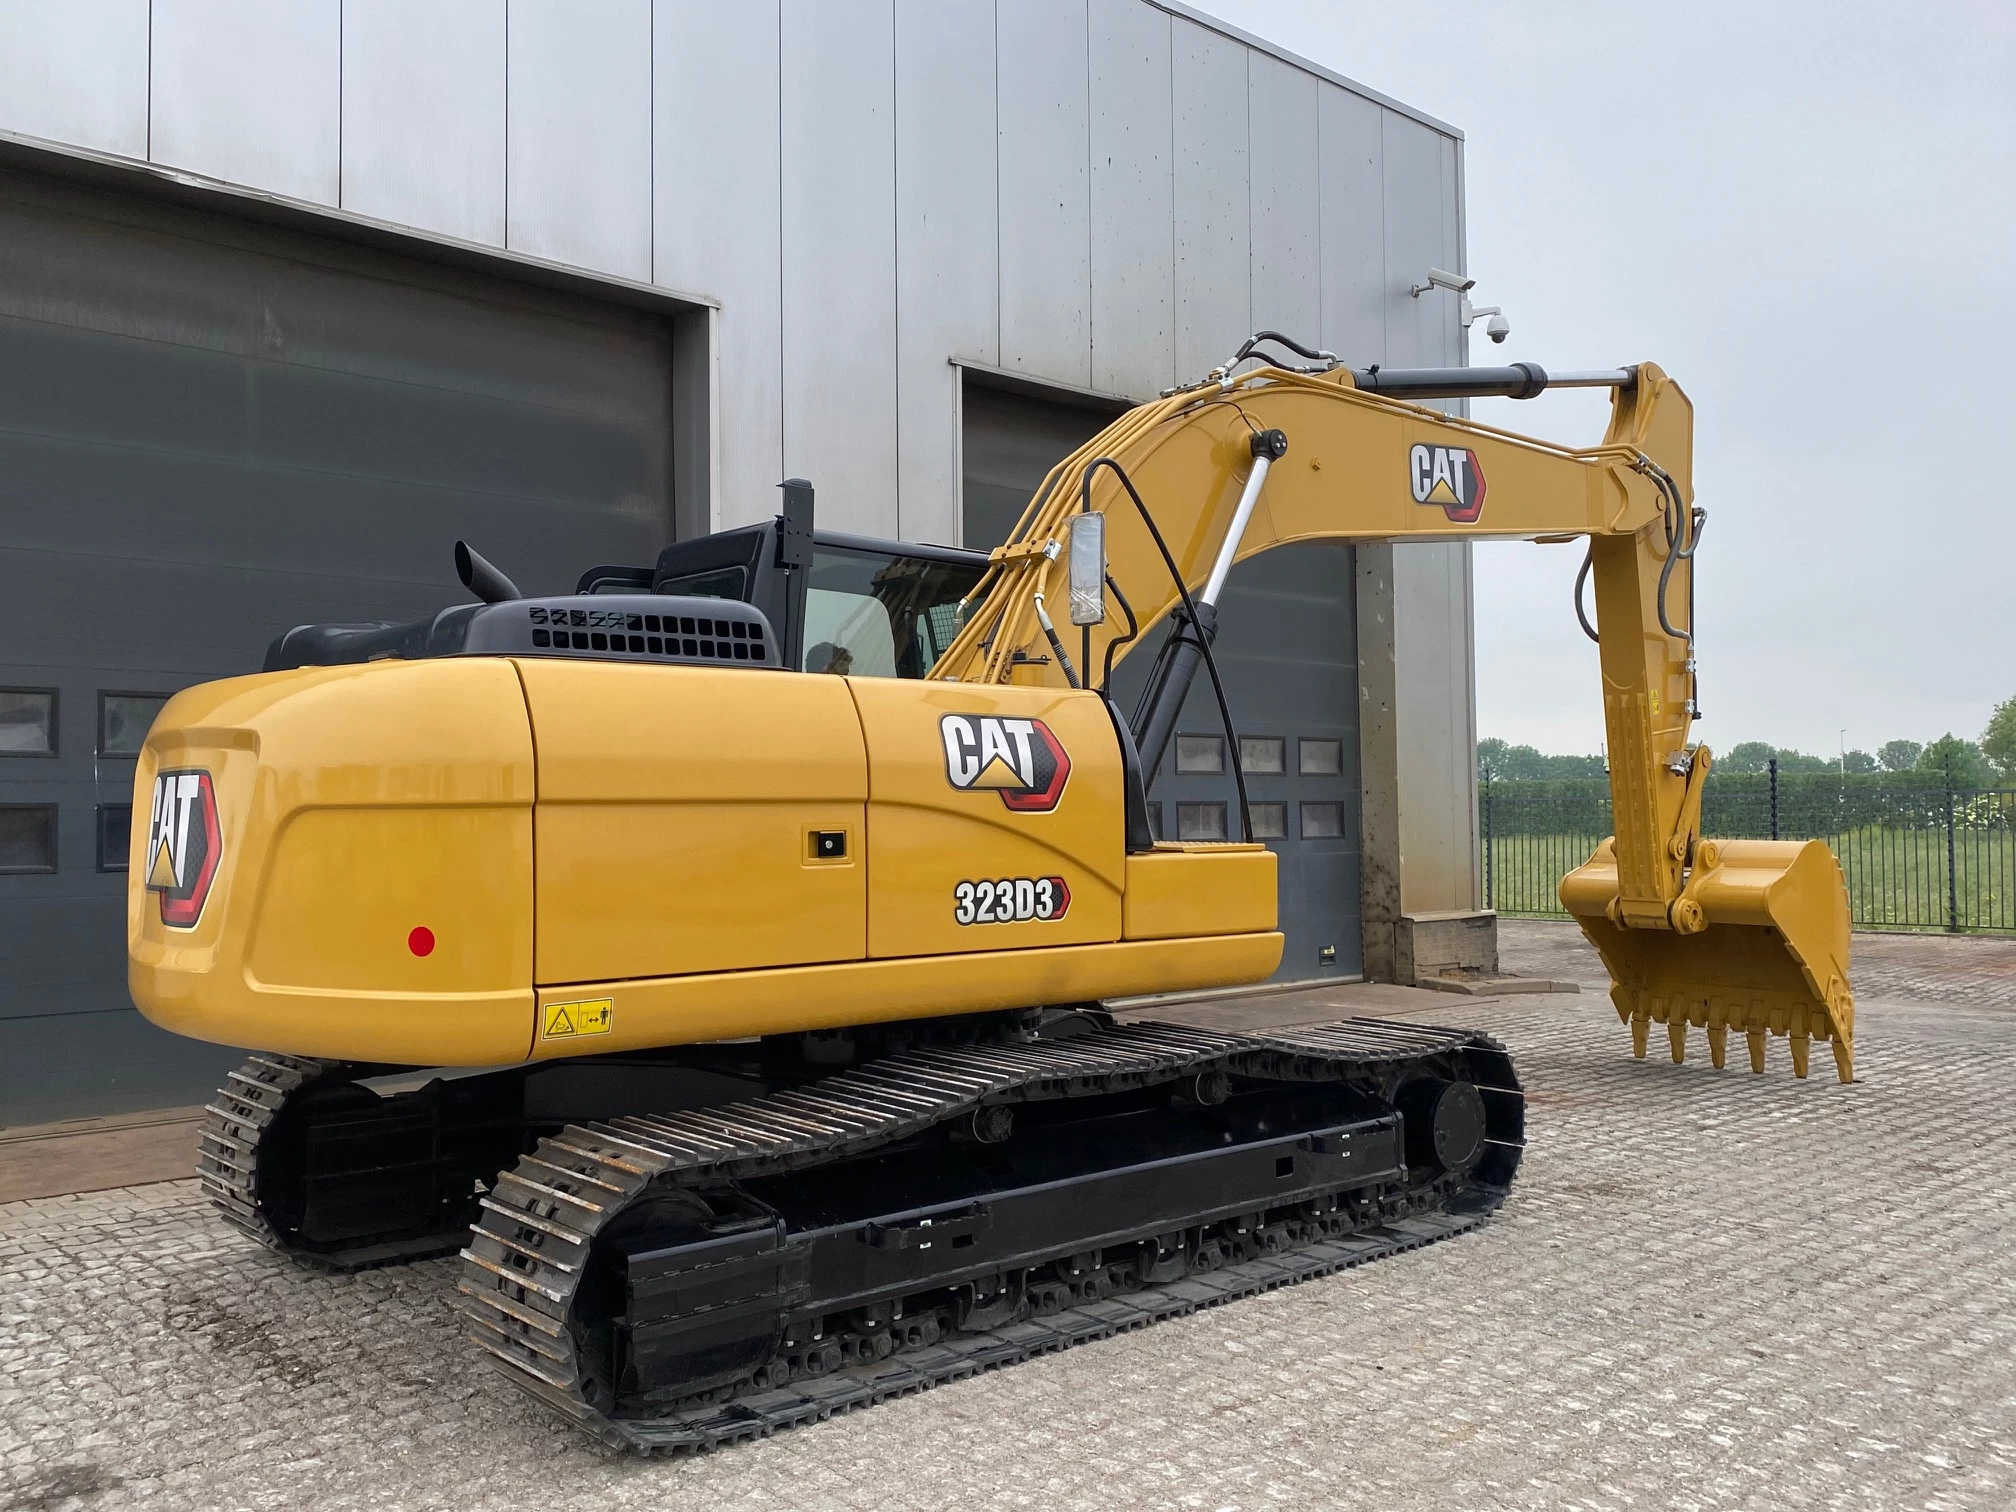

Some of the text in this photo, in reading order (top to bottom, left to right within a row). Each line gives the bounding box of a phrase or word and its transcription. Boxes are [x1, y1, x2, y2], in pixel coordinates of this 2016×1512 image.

[1411, 445, 1466, 504] CAT
[941, 715, 1034, 787] CAT
[146, 775, 199, 887] CAT
[956, 879, 1053, 923] 323D3
